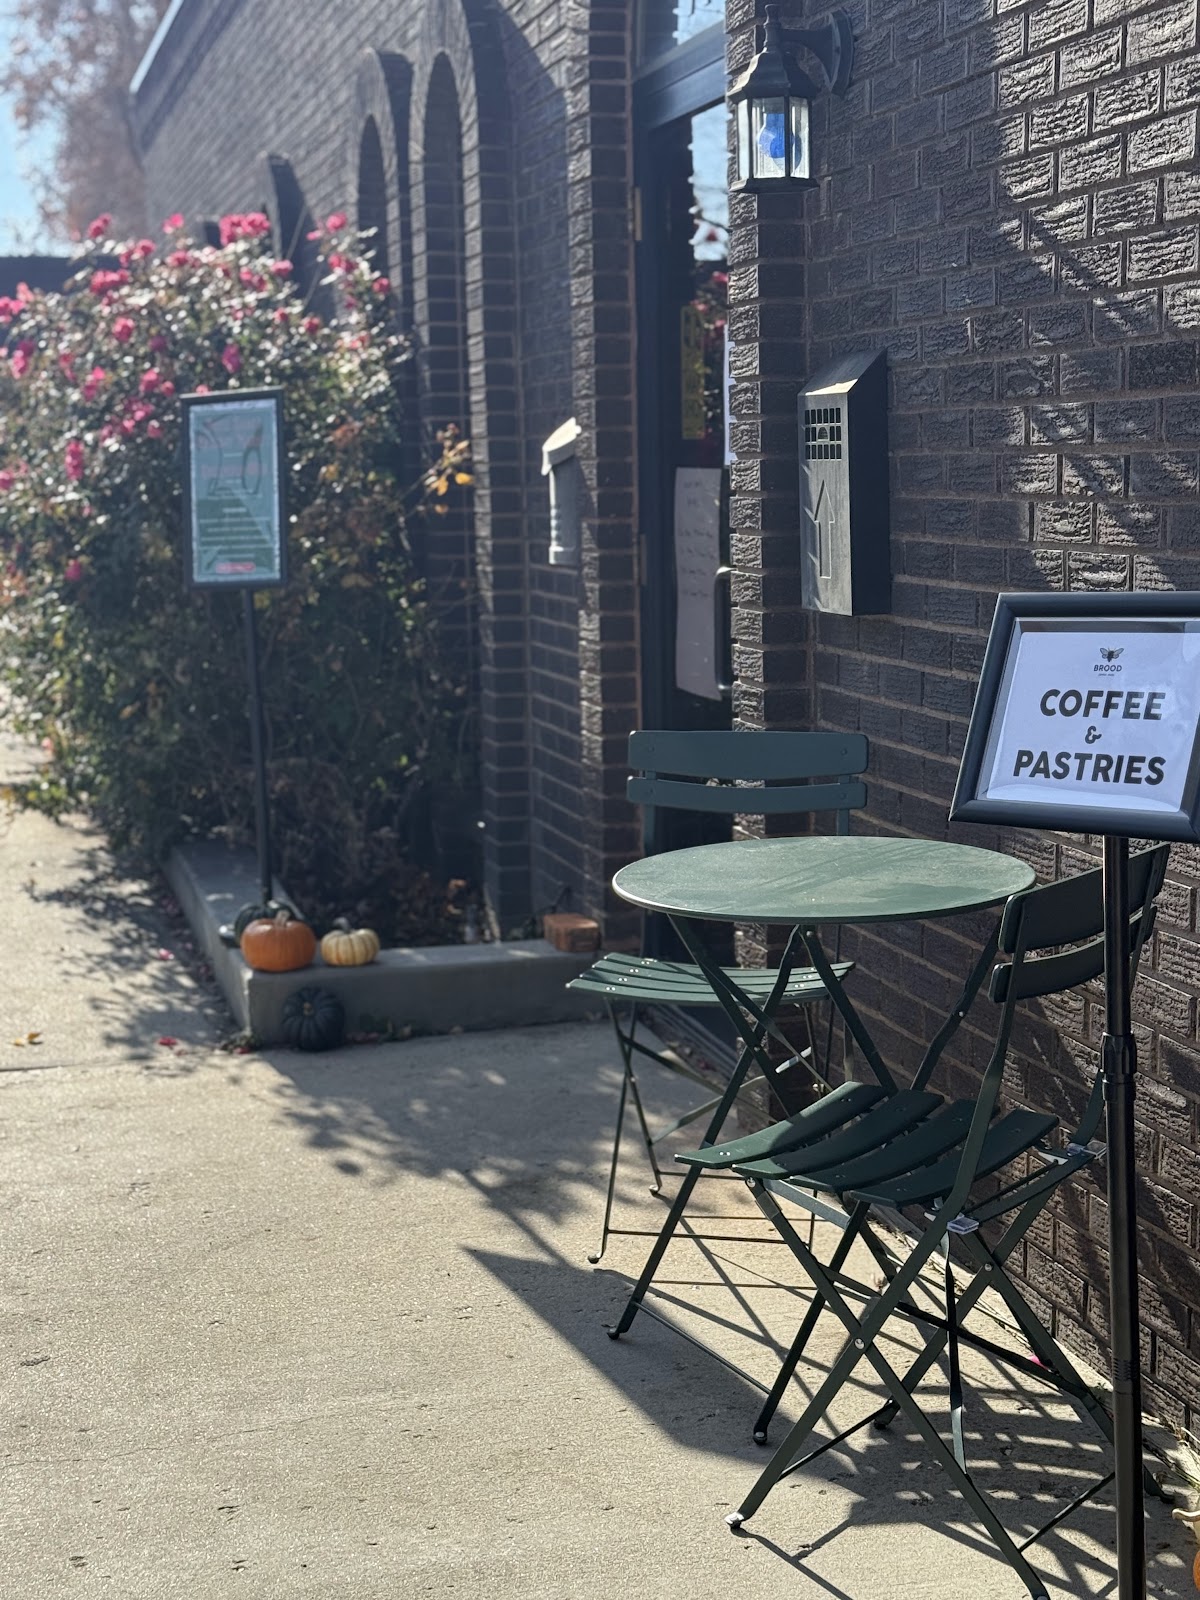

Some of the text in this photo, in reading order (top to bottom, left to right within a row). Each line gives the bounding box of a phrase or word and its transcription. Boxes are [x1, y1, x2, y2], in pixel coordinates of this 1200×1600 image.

[1093, 664, 1123, 672] BROOD
[1040, 689, 1166, 721] COFFEE
[1084, 725, 1102, 745] &
[1013, 749, 1167, 786] PASTRIES
